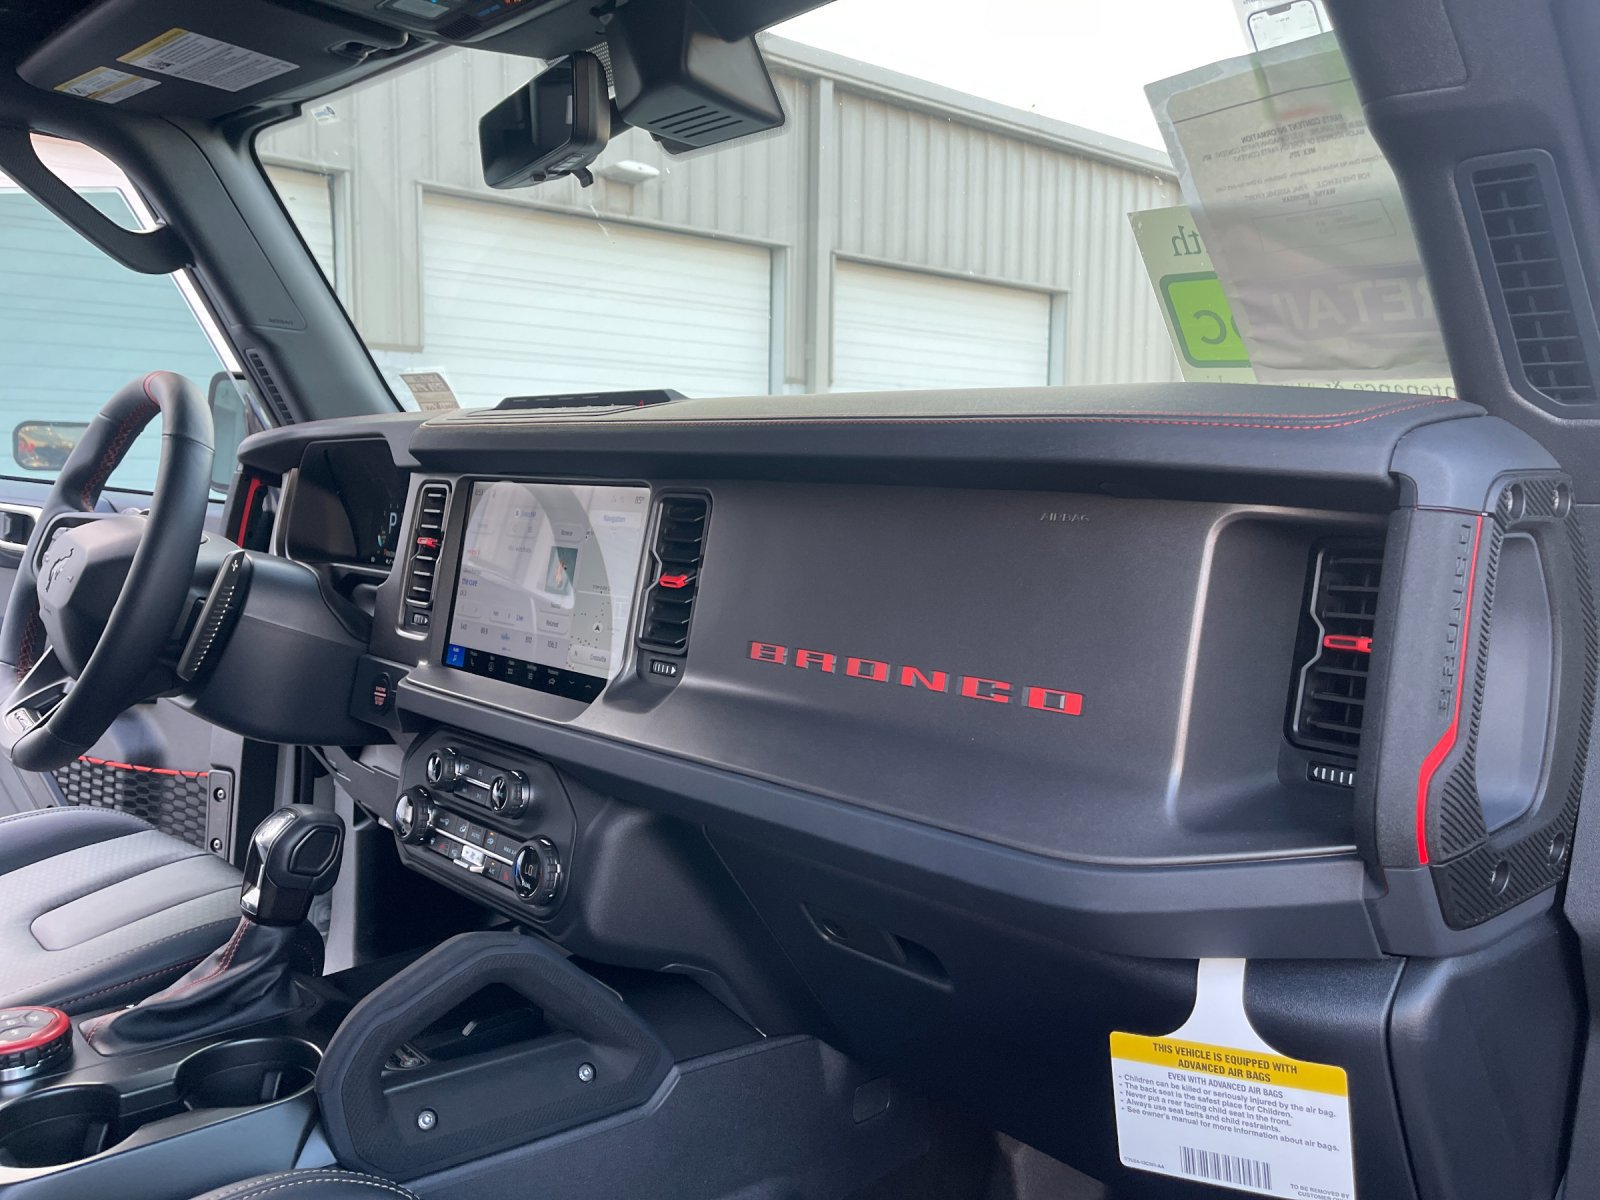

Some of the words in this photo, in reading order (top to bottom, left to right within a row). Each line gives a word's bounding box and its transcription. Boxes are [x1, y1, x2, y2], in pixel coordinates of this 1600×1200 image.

[388, 511, 398, 534] P
[748, 641, 1084, 716] BRONCO
[1153, 1042, 1173, 1054] THIS
[1175, 1046, 1211, 1060] VEHICLE
[1214, 1053, 1222, 1062] IS
[1225, 1055, 1270, 1070] EQUIPPED
[1272, 1062, 1297, 1074] WITH
[1178, 1059, 1225, 1075] ADVANCED
[1228, 1067, 1243, 1078] AIR
[1246, 1070, 1271, 1082] BAGS
[1124, 1074, 1154, 1085] Children
[1156, 1080, 1169, 1089] can
[1171, 1082, 1180, 1090] be
[1181, 1084, 1202, 1094] killed
[1203, 1088, 1212, 1096] or
[1213, 1091, 1248, 1104] seriously
[1250, 1096, 1277, 1107] injured
[1279, 1101, 1289, 1111] by
[1290, 1103, 1304, 1112] the
[1306, 1105, 1316, 1114] air
[1318, 1108, 1336, 1119] bag.
[1124, 1082, 1139, 1090] The
[1140, 1084, 1158, 1094] back
[1159, 1088, 1174, 1097] seat
[1175, 1090, 1183, 1098] is
[1184, 1092, 1196, 1101] the
[1197, 1095, 1220, 1105] safest
[1222, 1099, 1243, 1110] place
[1244, 1103, 1255, 1112] for
[1257, 1105, 1293, 1119] Children.
[1168, 1072, 1186, 1082] EVEN
[1188, 1075, 1207, 1085] WITH
[1208, 1080, 1246, 1092] ADVANCED
[1248, 1086, 1261, 1095] AIR
[1263, 1088, 1283, 1099] BAGS
[1125, 1090, 1147, 1100] Never
[1148, 1094, 1160, 1103] put
[1167, 1098, 1182, 1106] rear
[1184, 1100, 1207, 1112] facing
[1208, 1105, 1227, 1115] child
[1228, 1110, 1245, 1118] seat
[1246, 1112, 1254, 1120] in
[1256, 1113, 1269, 1122] the
[1270, 1115, 1292, 1127] front.
[1126, 1098, 1152, 1109] Always
[1168, 1106, 1184, 1115] seat
[1185, 1109, 1204, 1119] belts
[1205, 1113, 1220, 1122] and
[1221, 1116, 1240, 1126] child
[1241, 1120, 1281, 1133] restraints.
[1127, 1106, 1141, 1115] See
[1142, 1110, 1170, 1121] owner's
[1171, 1115, 1199, 1126] manual
[1200, 1120, 1211, 1128] for
[1212, 1123, 1233, 1132] more
[1234, 1125, 1278, 1141] information
[1280, 1135, 1303, 1145] about
[1304, 1139, 1316, 1147] air
[1317, 1141, 1340, 1152] bags.
